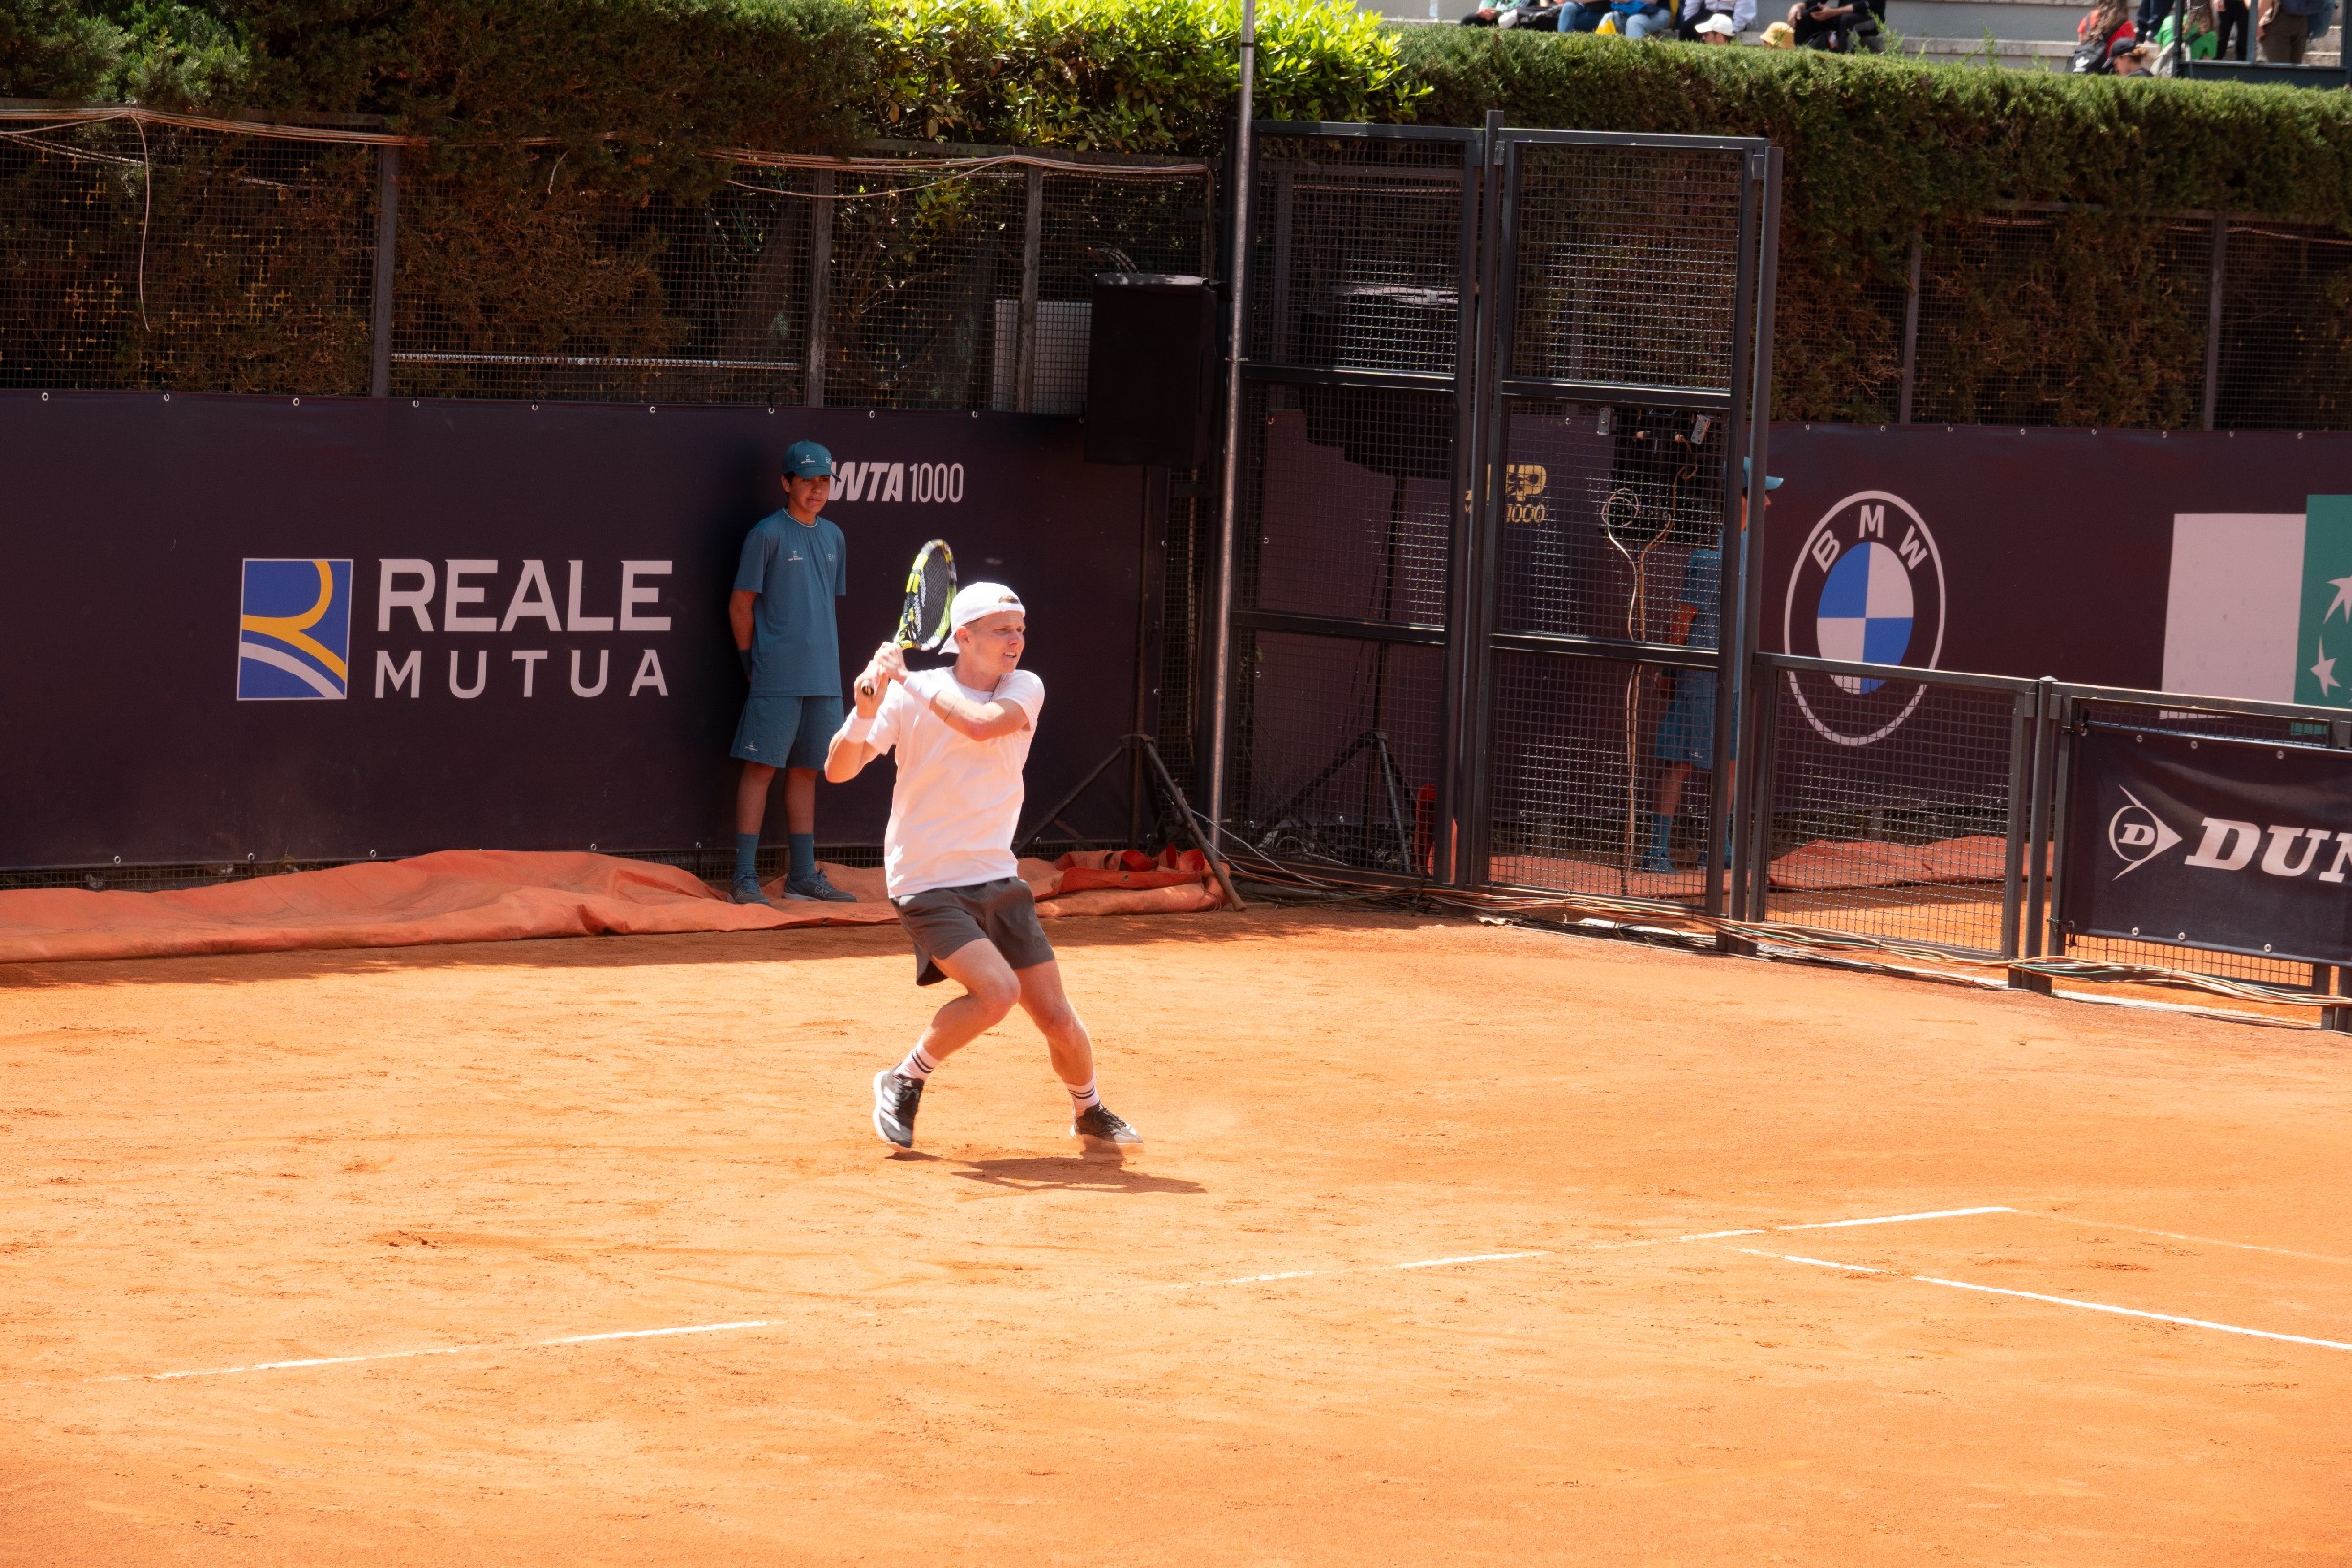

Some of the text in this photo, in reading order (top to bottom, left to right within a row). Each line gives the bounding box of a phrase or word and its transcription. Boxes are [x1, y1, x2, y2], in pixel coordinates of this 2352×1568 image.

[828, 462, 964, 503] WTA 1000
[1812, 504, 1928, 573] BMW
[378, 558, 673, 632] REALE
[374, 649, 669, 699] MUTUA
[2118, 823, 2156, 846] D
